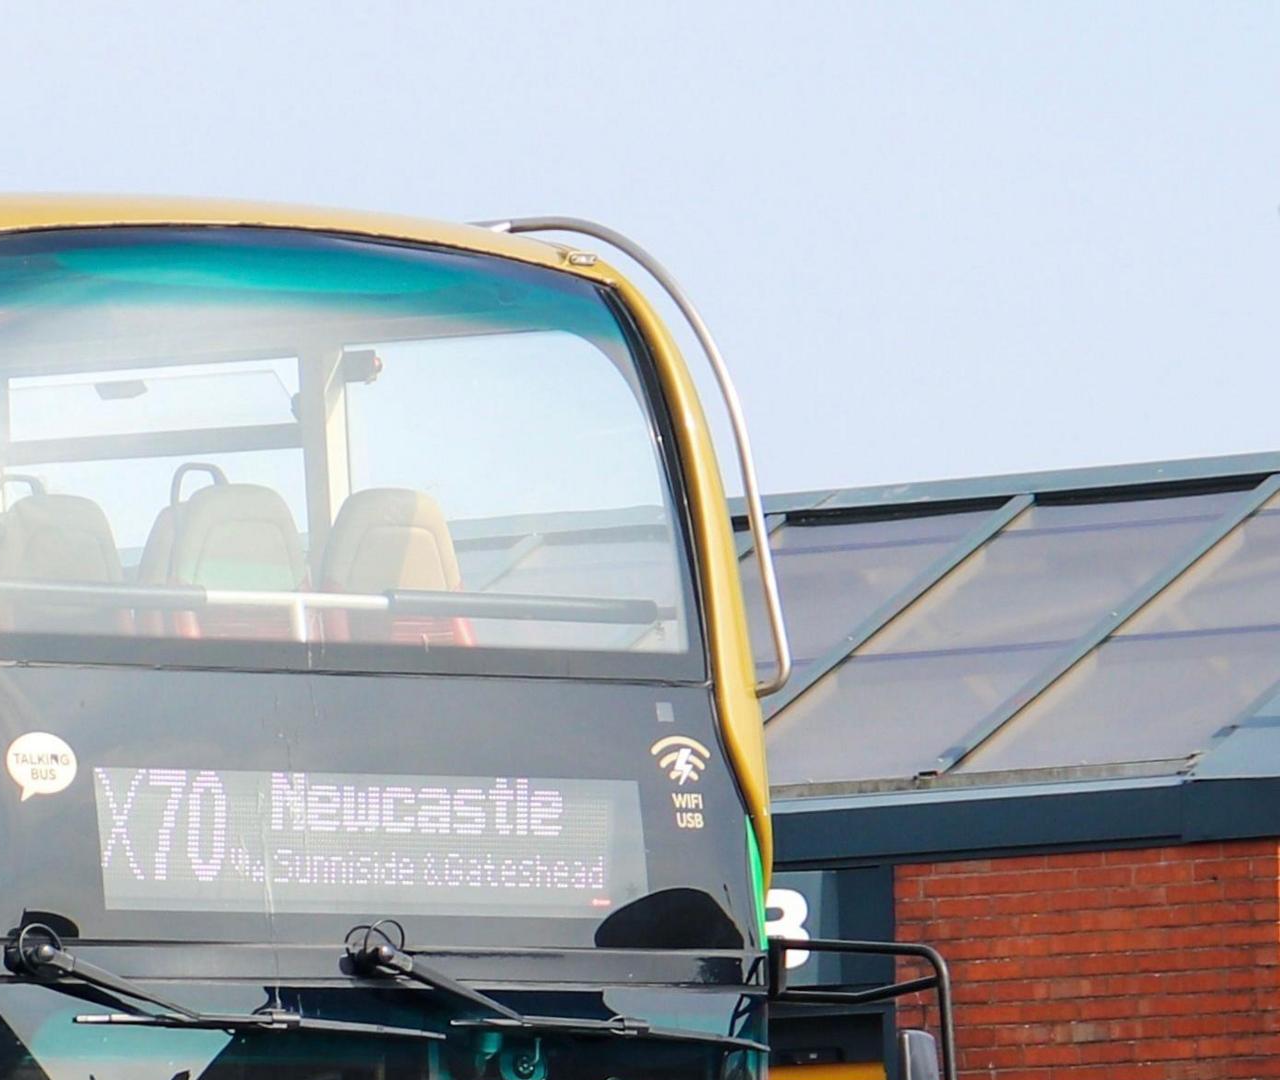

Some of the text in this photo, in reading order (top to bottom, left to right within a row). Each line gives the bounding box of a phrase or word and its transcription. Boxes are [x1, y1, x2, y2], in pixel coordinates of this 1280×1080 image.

[13, 752, 70, 767] TALKING
[30, 767, 57, 781] BUS
[270, 772, 564, 836] Newcastle
[672, 793, 703, 810] WIFI
[94, 767, 227, 881] X70
[676, 813, 704, 828] USB
[273, 849, 414, 886] Sunniside
[445, 853, 605, 890] Gateshead
